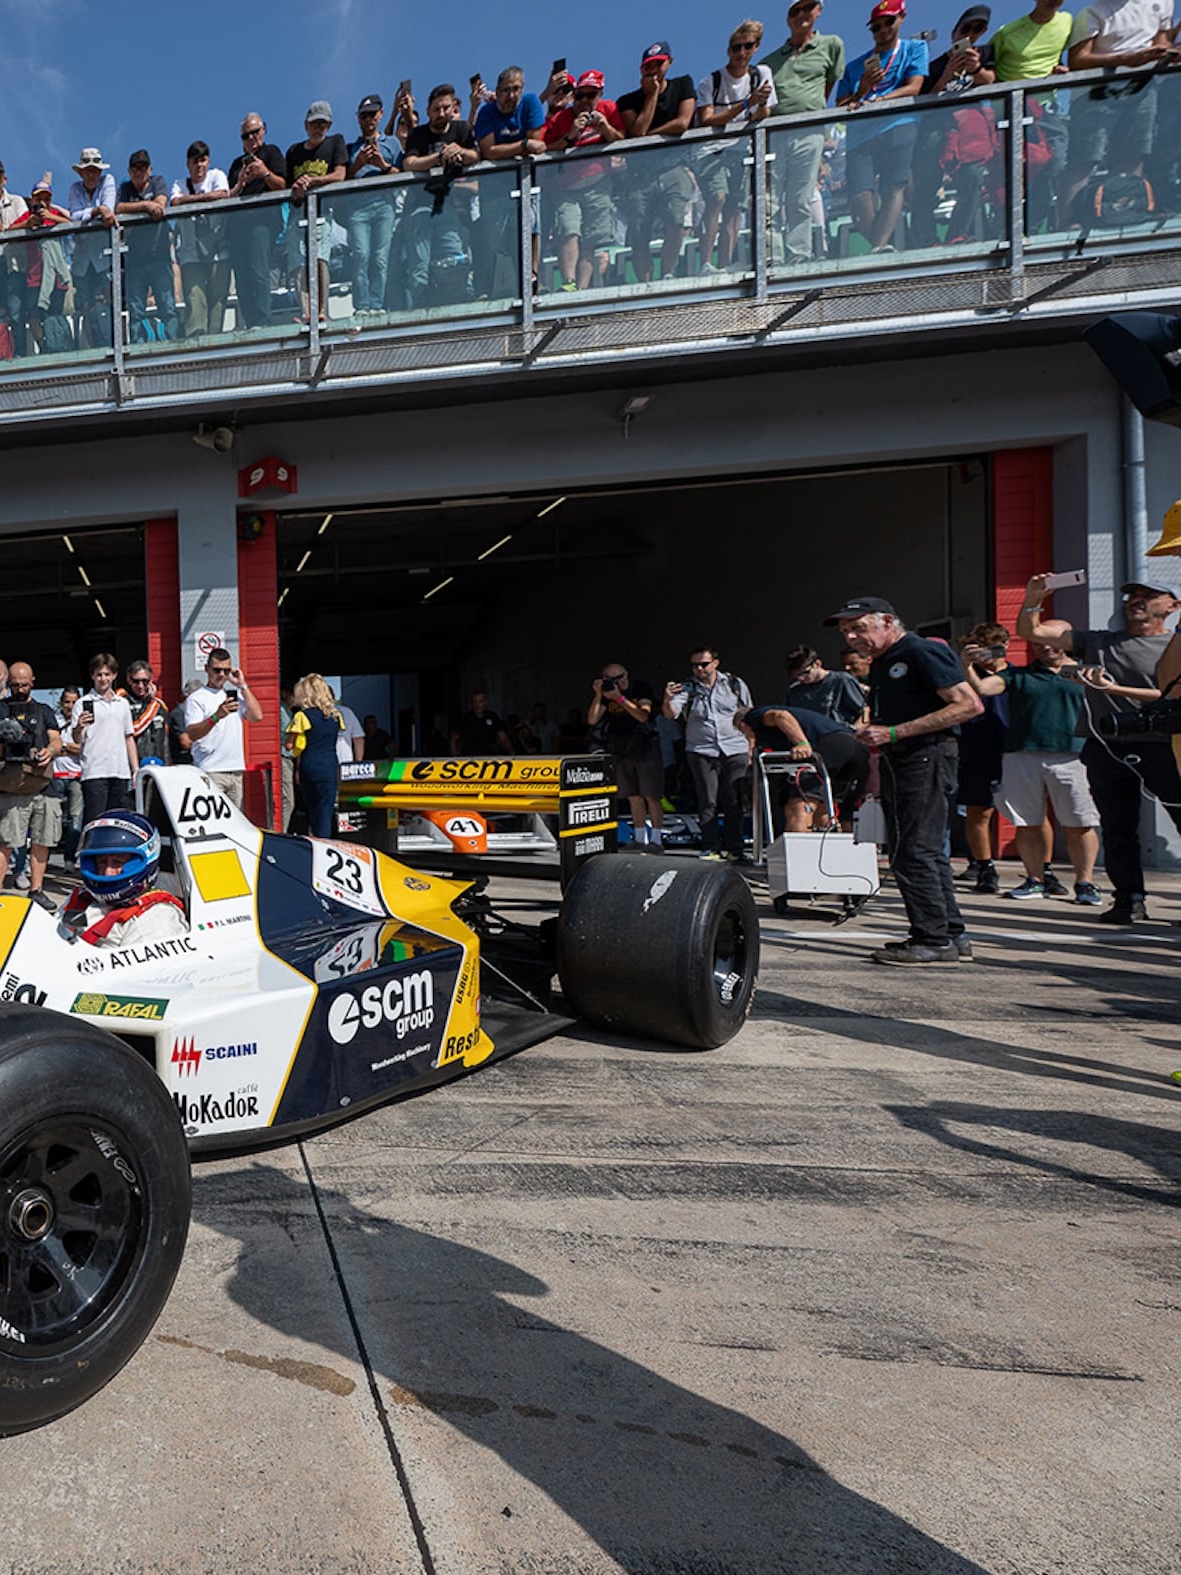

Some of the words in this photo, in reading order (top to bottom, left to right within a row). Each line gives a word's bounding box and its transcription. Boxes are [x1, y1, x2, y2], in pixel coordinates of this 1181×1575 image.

[249, 467, 265, 487] 9
[438, 760, 514, 779] scm
[520, 766, 560, 779] grou
[568, 798, 610, 825] PIRELLI
[450, 820, 479, 833] 41
[326, 848, 364, 894] 23
[109, 937, 198, 970] ATLANTIC
[102, 1001, 163, 1020] RAFAL
[361, 969, 434, 1029] scm
[396, 1008, 434, 1040] group
[206, 1042, 258, 1060] SCAINI
